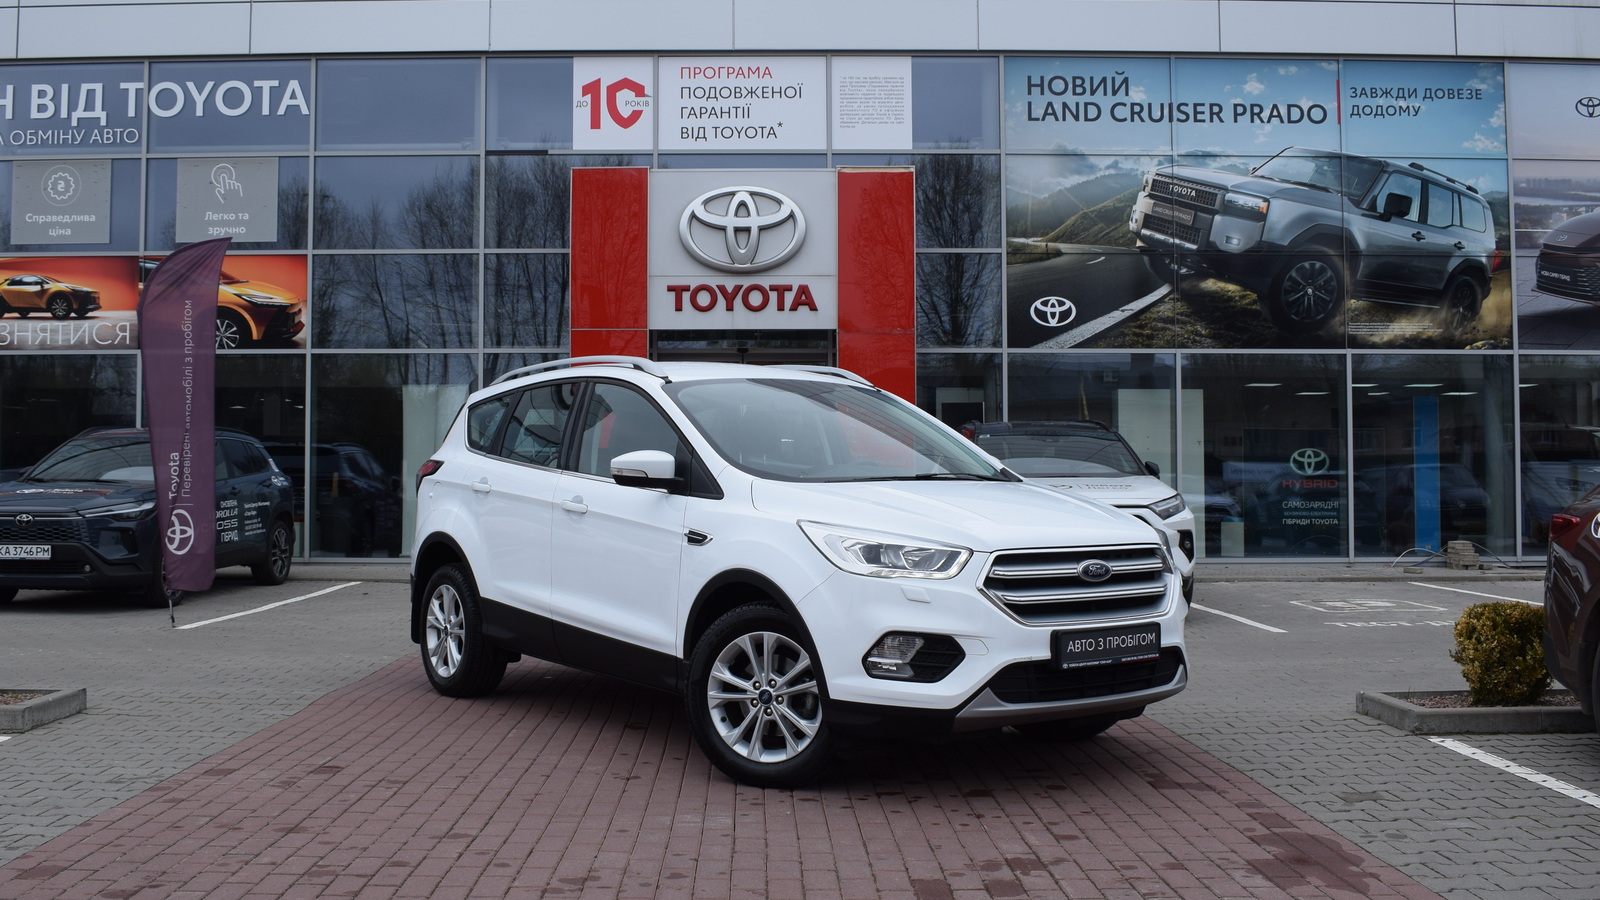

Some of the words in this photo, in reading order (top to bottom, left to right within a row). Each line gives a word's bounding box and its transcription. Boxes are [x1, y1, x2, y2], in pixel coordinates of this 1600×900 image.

[680, 66, 773, 80] ПРОГРАМА
[1027, 70, 1130, 97] НОВИЙ
[680, 83, 804, 102] ПОДОВЖЕНОЇ
[1350, 86, 1418, 103] ЗАВЖДИ
[1422, 88, 1483, 103] ДОВЕЗЕ
[30, 83, 107, 127] ВІД
[120, 80, 310, 118] TOYOTA
[576, 100, 589, 109] ДО
[625, 100, 650, 108] РОКІВ
[680, 103, 752, 120] ГАРАНТІЇ
[1027, 101, 1102, 122] LAND
[1110, 101, 1224, 124] CRUISER
[1233, 102, 1328, 125] PRADO
[1350, 104, 1421, 120] ДОДОМУ
[10, 129, 86, 146] ОБМІНУ
[90, 128, 140, 145] АВТО
[680, 126, 707, 142] ВІД
[25, 213, 96, 225] Справедлива
[204, 211, 236, 221] Легко
[238, 213, 249, 221] та
[49, 226, 71, 237] ціна
[207, 225, 247, 236] зручно
[667, 283, 819, 312] TOYOTA
[181, 300, 195, 353] пробігом
[168, 452, 180, 499] Toyota
[1282, 479, 1339, 489] HYBRID
[1282, 501, 1339, 509] САМОЗАРЯДНІ
[216, 518, 238, 529] OSS
[12, 546, 35, 556] 3746
[1067, 638, 1095, 653] АВТО
[1106, 632, 1156, 649] ПРОБІГОМ
